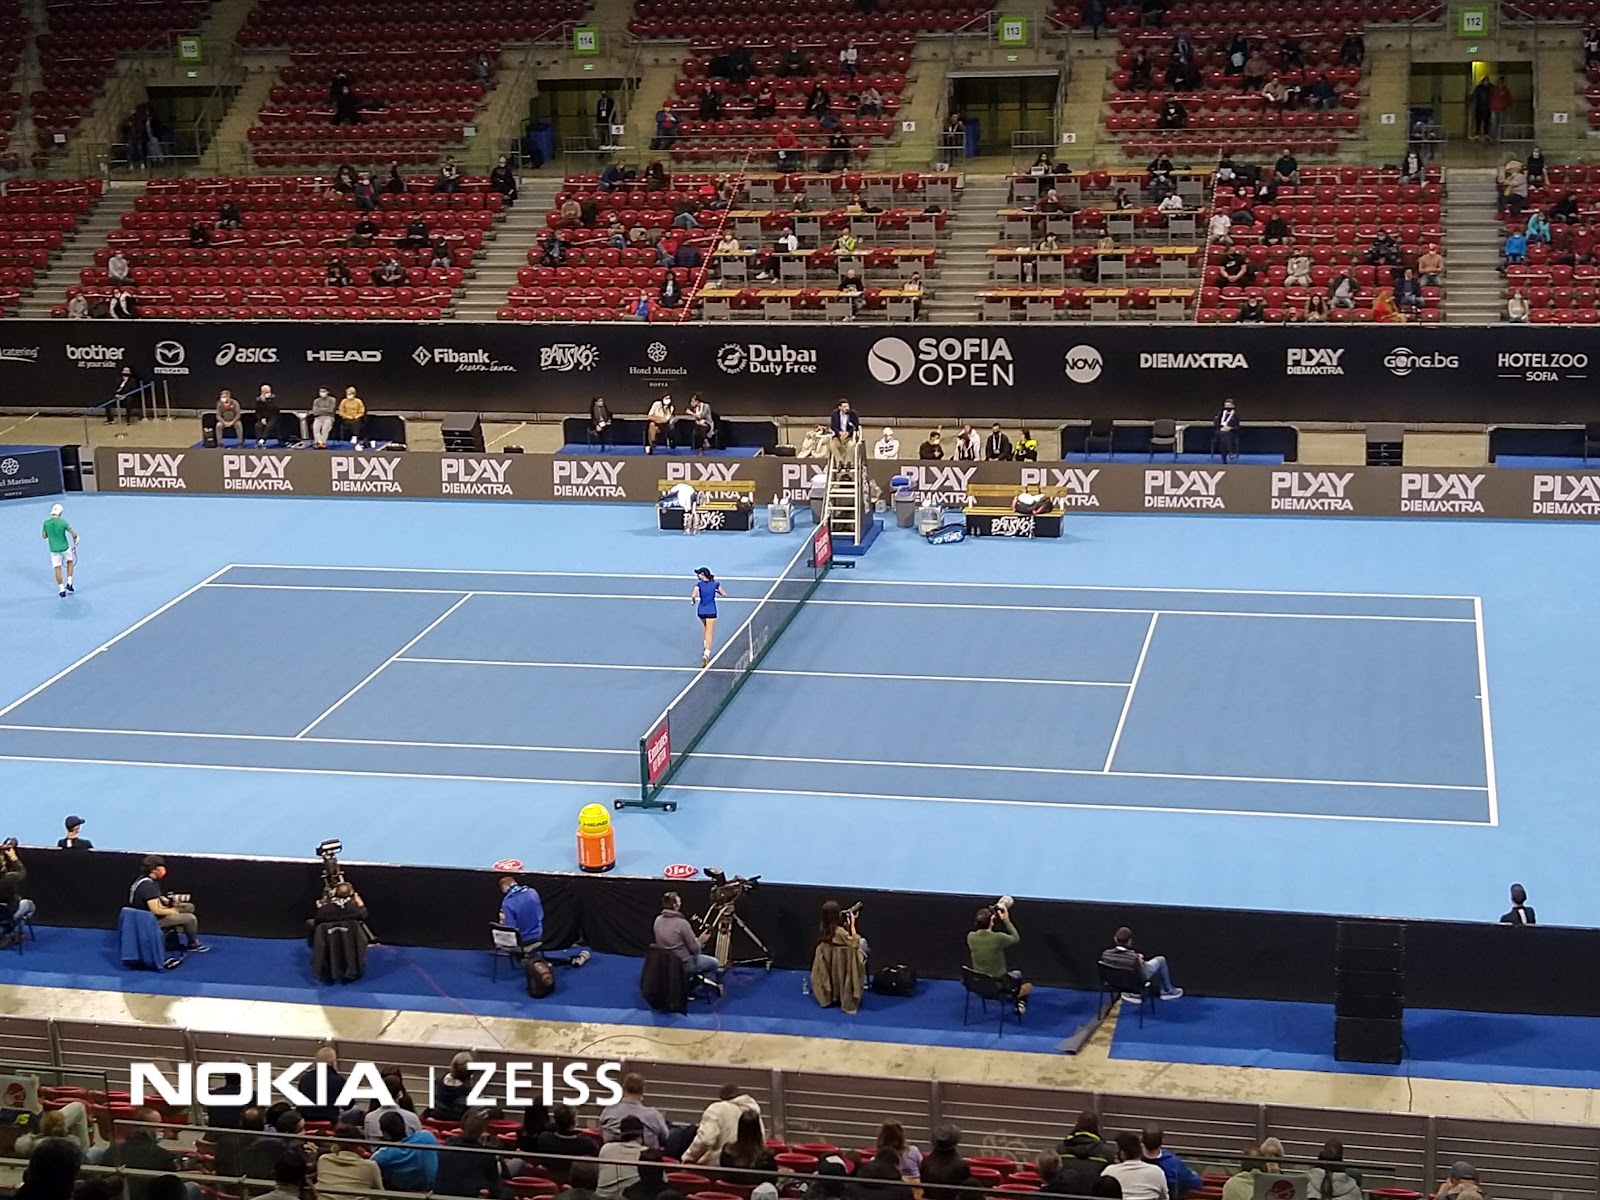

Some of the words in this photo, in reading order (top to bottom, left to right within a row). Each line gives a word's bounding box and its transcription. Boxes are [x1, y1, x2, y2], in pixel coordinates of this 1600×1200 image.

[1466, 17, 1481, 26] 112
[1006, 26, 1020, 36] 113
[579, 36, 593, 45] 114
[66, 344, 125, 360] brother
[748, 344, 817, 362] Dubai
[918, 337, 1013, 361] SOFIA
[306, 350, 382, 362] HEAD
[433, 349, 491, 363] Fibank
[540, 344, 594, 371] BANSKO
[1140, 353, 1249, 369] DIEMAXTRA
[1497, 353, 1550, 368] HOTEL
[1550, 353, 1589, 368] ZOO
[749, 362, 783, 376] Duty
[785, 362, 817, 374] Free
[1065, 357, 1102, 370] NOVA
[629, 367, 651, 375] Hotel
[652, 367, 687, 375] Marinela
[918, 363, 1015, 386] OPEN
[1286, 366, 1344, 375] DIEMAXTRA
[1525, 371, 1559, 382] SOFIA
[118, 477, 186, 489] DIEMAXTRA
[224, 478, 293, 491] DIEMAXTRA
[332, 480, 402, 493] DIEMAXTRA
[442, 482, 513, 495] DIEMAXTRA
[553, 485, 626, 498] DIEMAXTRA
[1144, 496, 1226, 509] DIEMAXTRA
[1271, 498, 1354, 511] DIEMAXTRA
[1400, 499, 1485, 513] DIEMAXTRA
